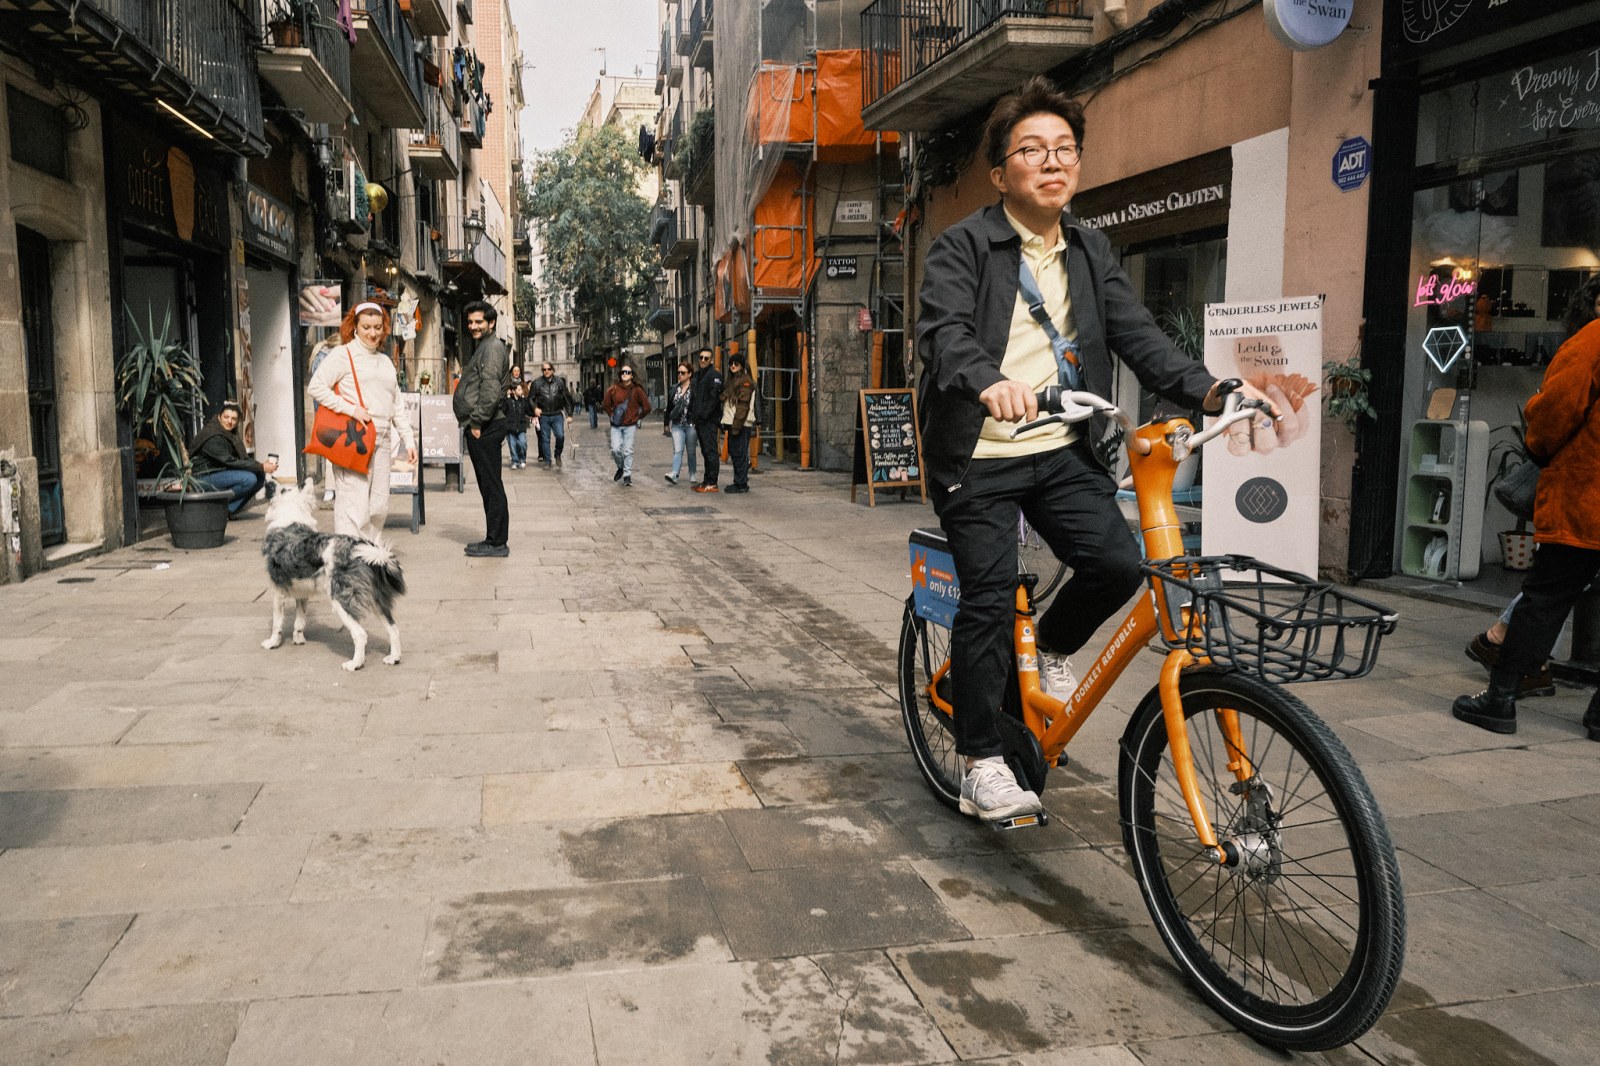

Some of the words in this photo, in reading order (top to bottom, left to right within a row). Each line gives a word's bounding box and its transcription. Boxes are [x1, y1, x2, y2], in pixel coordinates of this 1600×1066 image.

[1308, 0, 1346, 19] Swan
[1511, 66, 1581, 100] Dreamy
[1530, 99, 1557, 131] for
[1339, 150, 1366, 173] ADT
[128, 163, 165, 217] COFFEE
[1128, 200, 1165, 221] SENSE
[1166, 184, 1225, 211] GLUTEN
[1208, 303, 1276, 317] GENDERLESS
[1277, 301, 1320, 314] JEWELS
[1209, 327, 1240, 336] MADE
[1242, 326, 1253, 334] IN
[1255, 322, 1318, 334] BARCELONA
[1238, 342, 1269, 354] Leda
[1254, 356, 1289, 367] Swan
[929, 580, 947, 598] only
[1074, 664, 1102, 703] DONKEY
[1101, 617, 1137, 667] REPUBLIC
